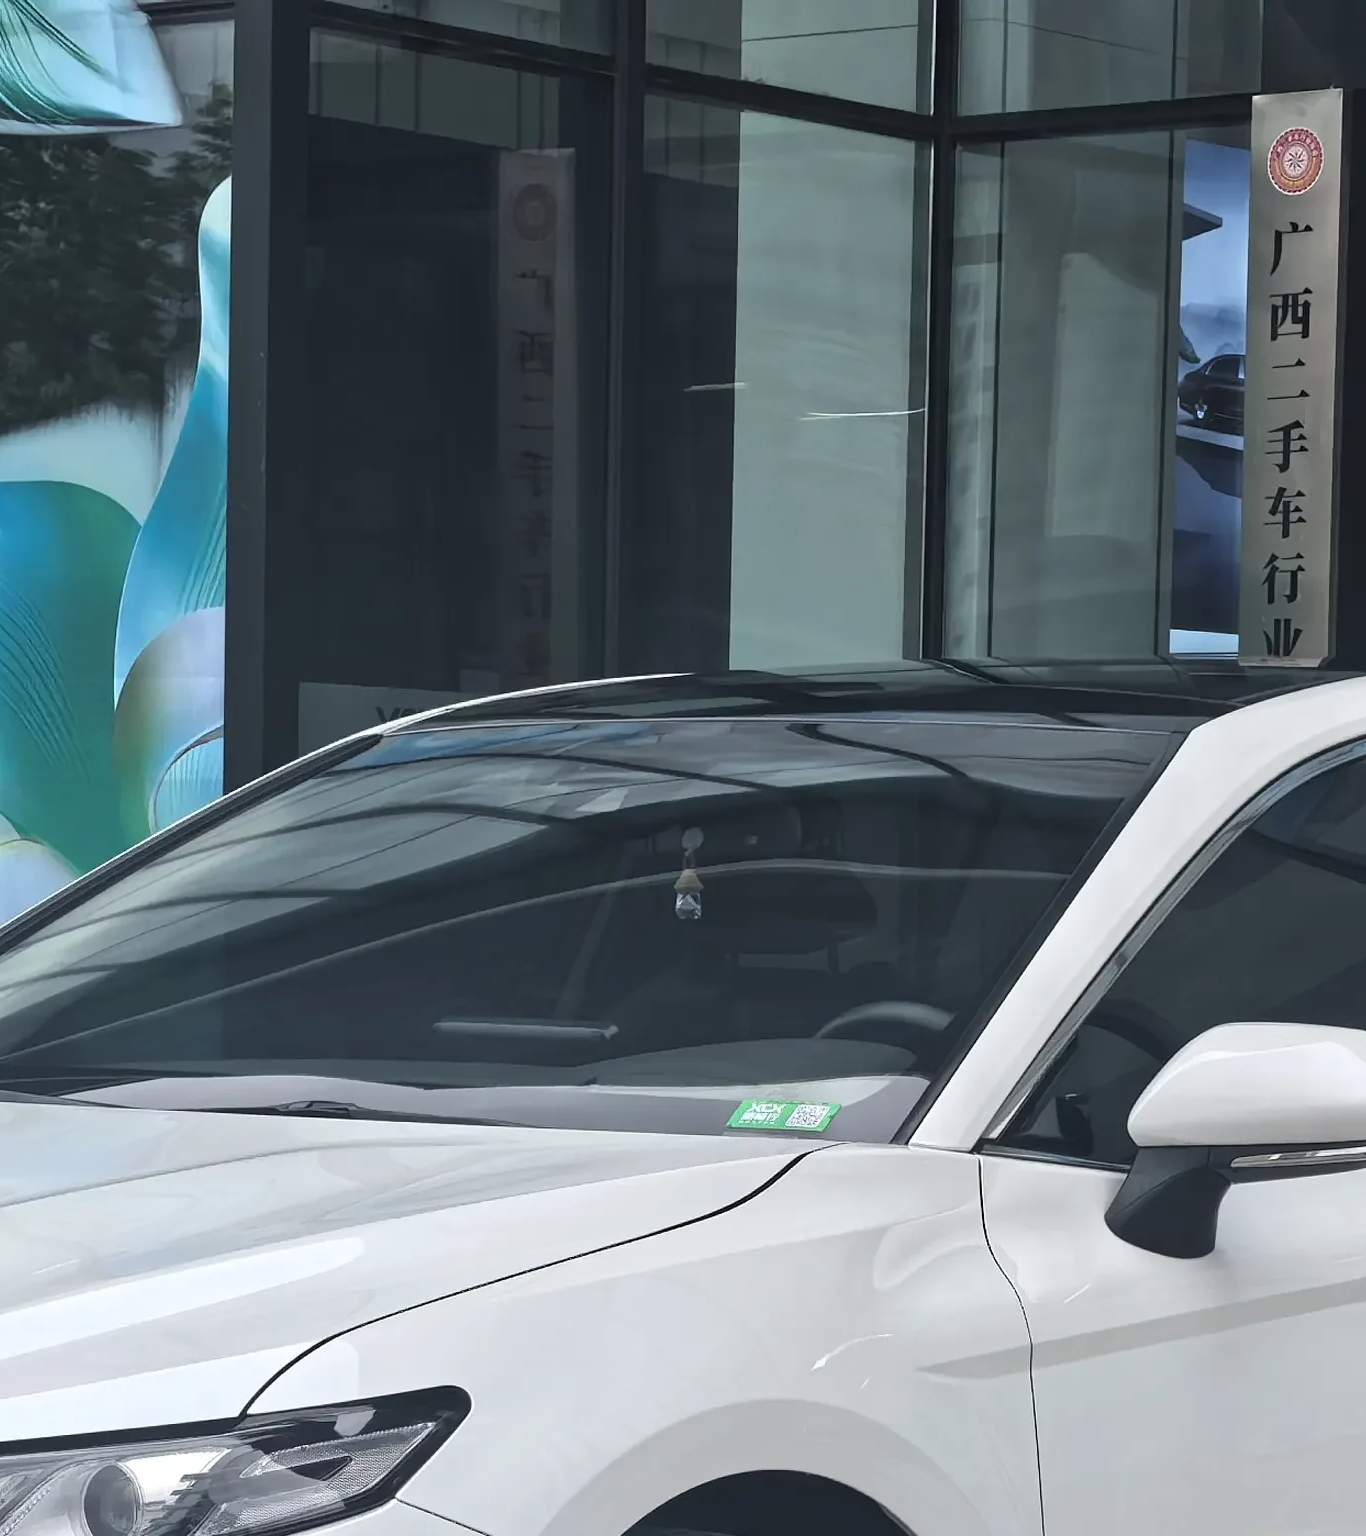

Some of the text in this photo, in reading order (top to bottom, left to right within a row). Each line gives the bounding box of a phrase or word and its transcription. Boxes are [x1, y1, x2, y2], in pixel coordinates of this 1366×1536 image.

[1260, 221, 1315, 658] 广西二手车行业
